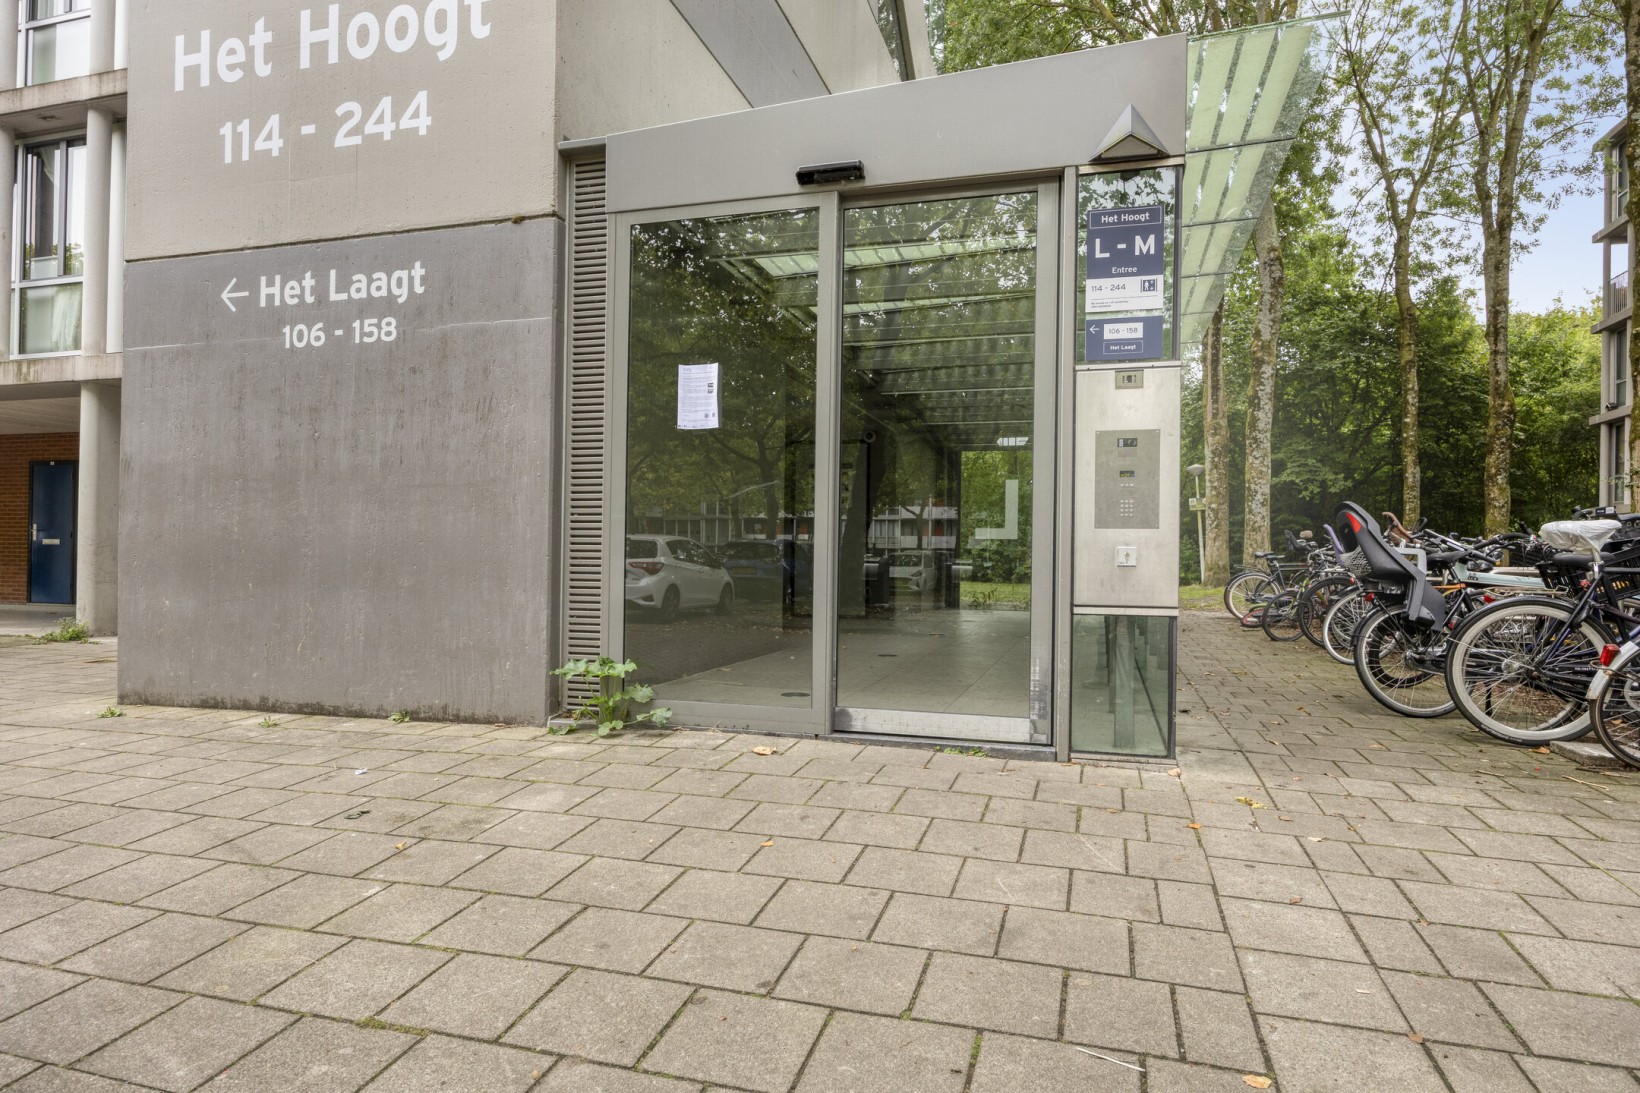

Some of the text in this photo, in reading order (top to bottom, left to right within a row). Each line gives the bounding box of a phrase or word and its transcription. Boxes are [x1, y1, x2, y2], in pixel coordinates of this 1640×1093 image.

[174, 0, 492, 92] Het Hoogt
[219, 90, 432, 164] 114 - 244
[1101, 211, 1150, 224] Het Hoogt
[1095, 238, 1110, 258] L
[1134, 234, 1155, 256] M
[259, 260, 426, 307] Het Laagt
[1111, 266, 1138, 274] Entree
[1091, 284, 1103, 293] 114
[1110, 283, 1126, 292] 244
[282, 321, 326, 348] 106
[352, 316, 397, 344] 158
